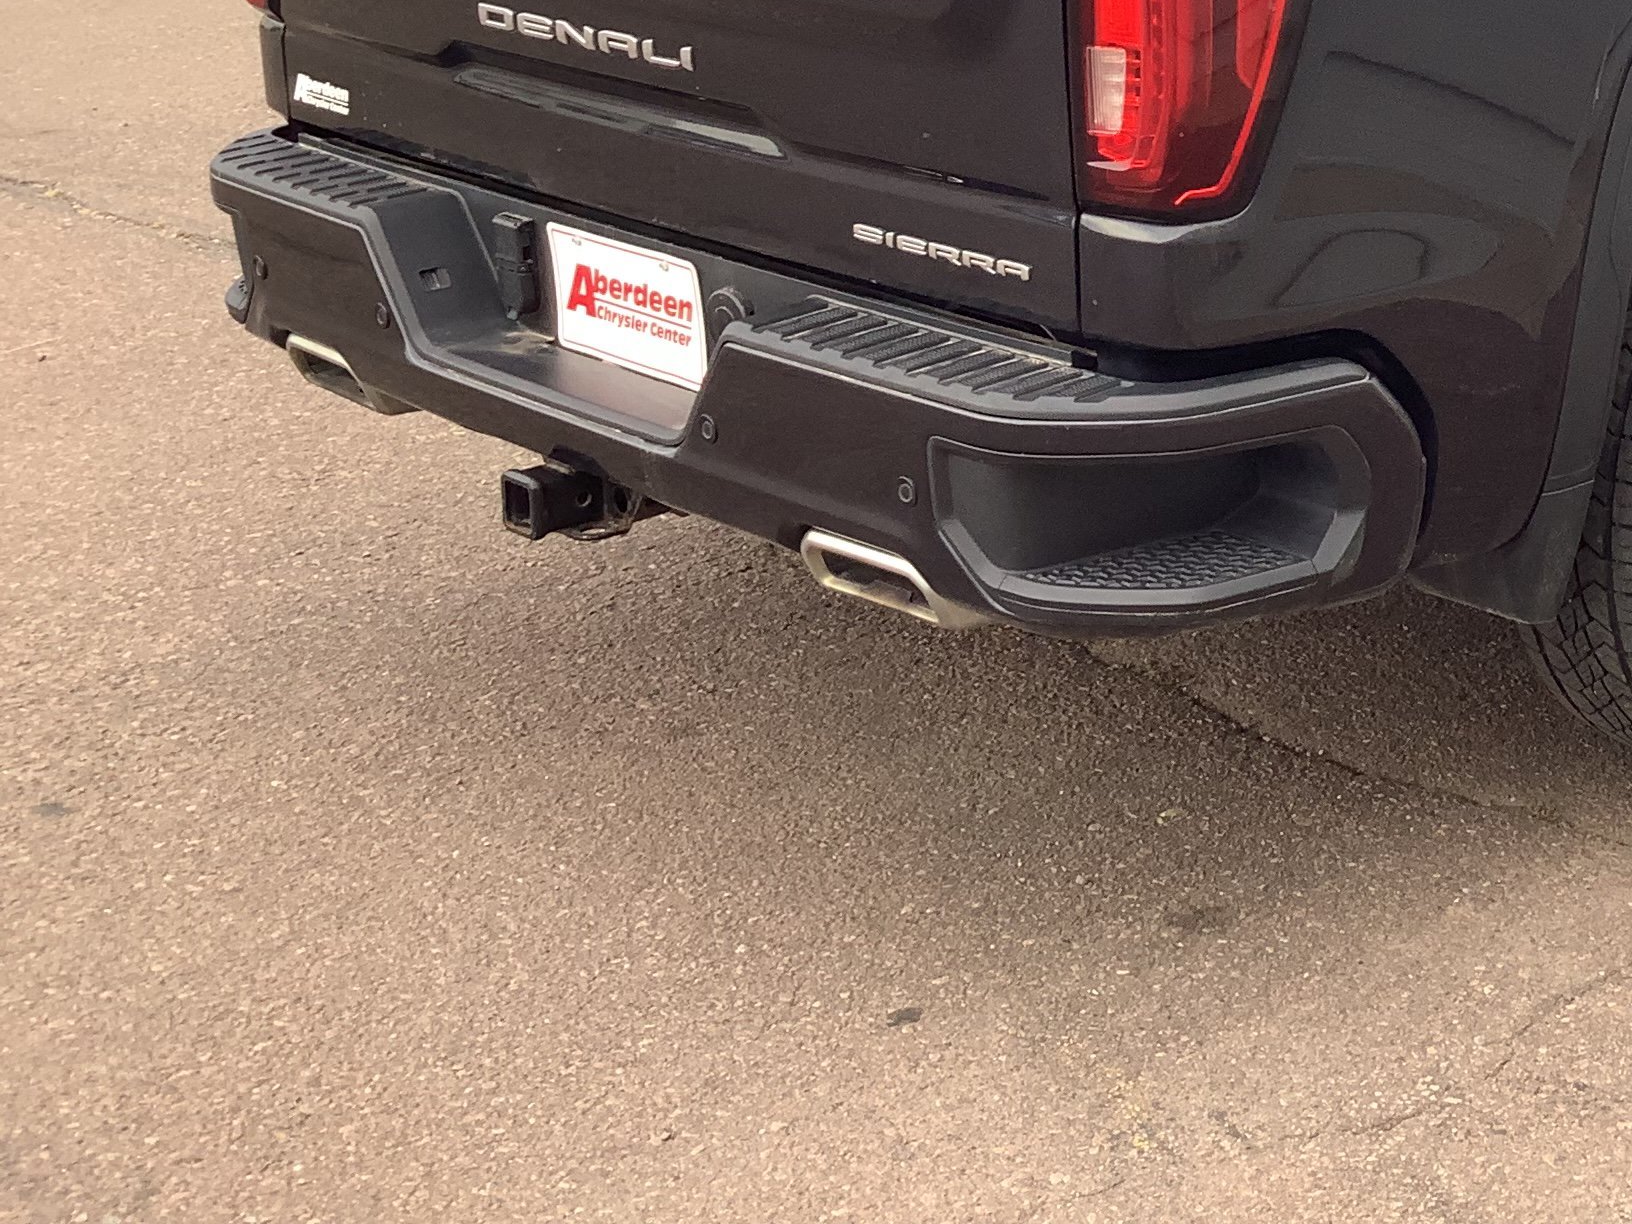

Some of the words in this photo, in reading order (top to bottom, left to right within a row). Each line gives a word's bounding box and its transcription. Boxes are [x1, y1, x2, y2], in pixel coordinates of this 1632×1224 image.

[477, 2, 694, 72] DENALI
[852, 223, 1032, 281] SIERRA
[567, 263, 693, 322] Aberdeen
[597, 305, 648, 333] Chrysler
[650, 322, 691, 347] Center
